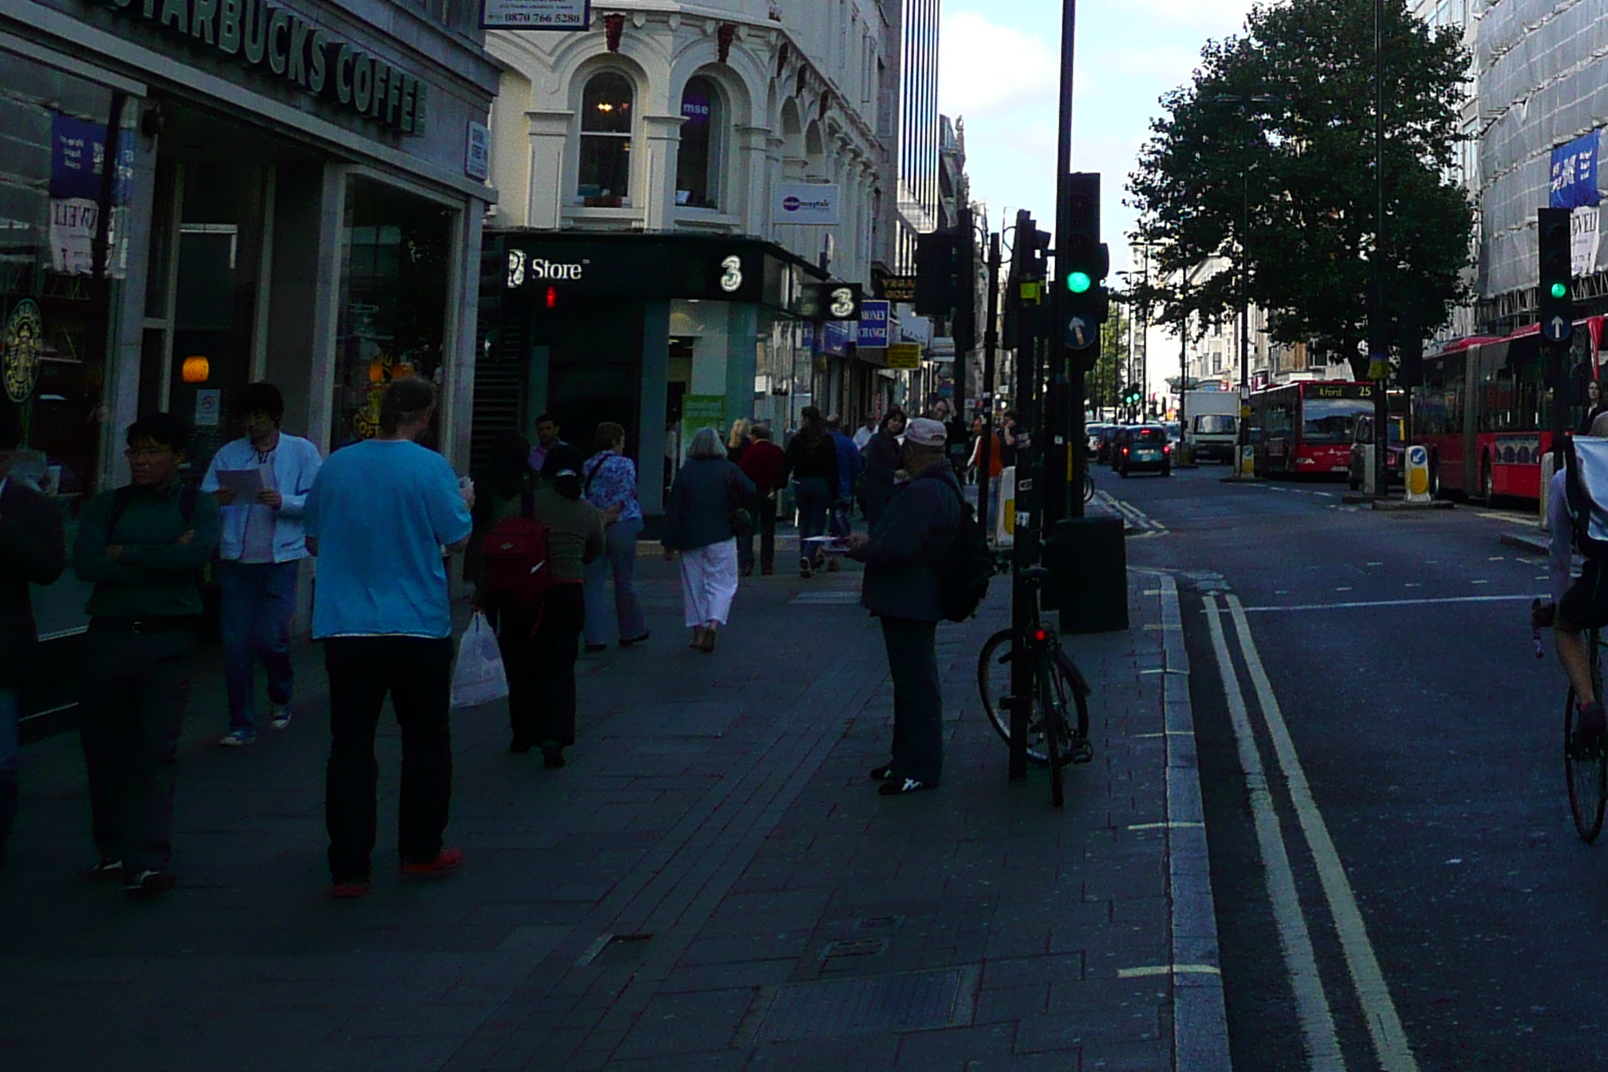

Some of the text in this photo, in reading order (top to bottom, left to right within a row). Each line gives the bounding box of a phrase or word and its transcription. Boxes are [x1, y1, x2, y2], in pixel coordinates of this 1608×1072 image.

[505, 13, 530, 21] 0870
[336, 43, 428, 137] COFFEE
[683, 104, 709, 115] mse
[533, 258, 582, 280] Store
[720, 255, 743, 292] 3
[830, 287, 854, 317] 3
[861, 310, 886, 321] MONEY
[857, 327, 886, 338] CHANGE
[1359, 386, 1372, 396] 25
